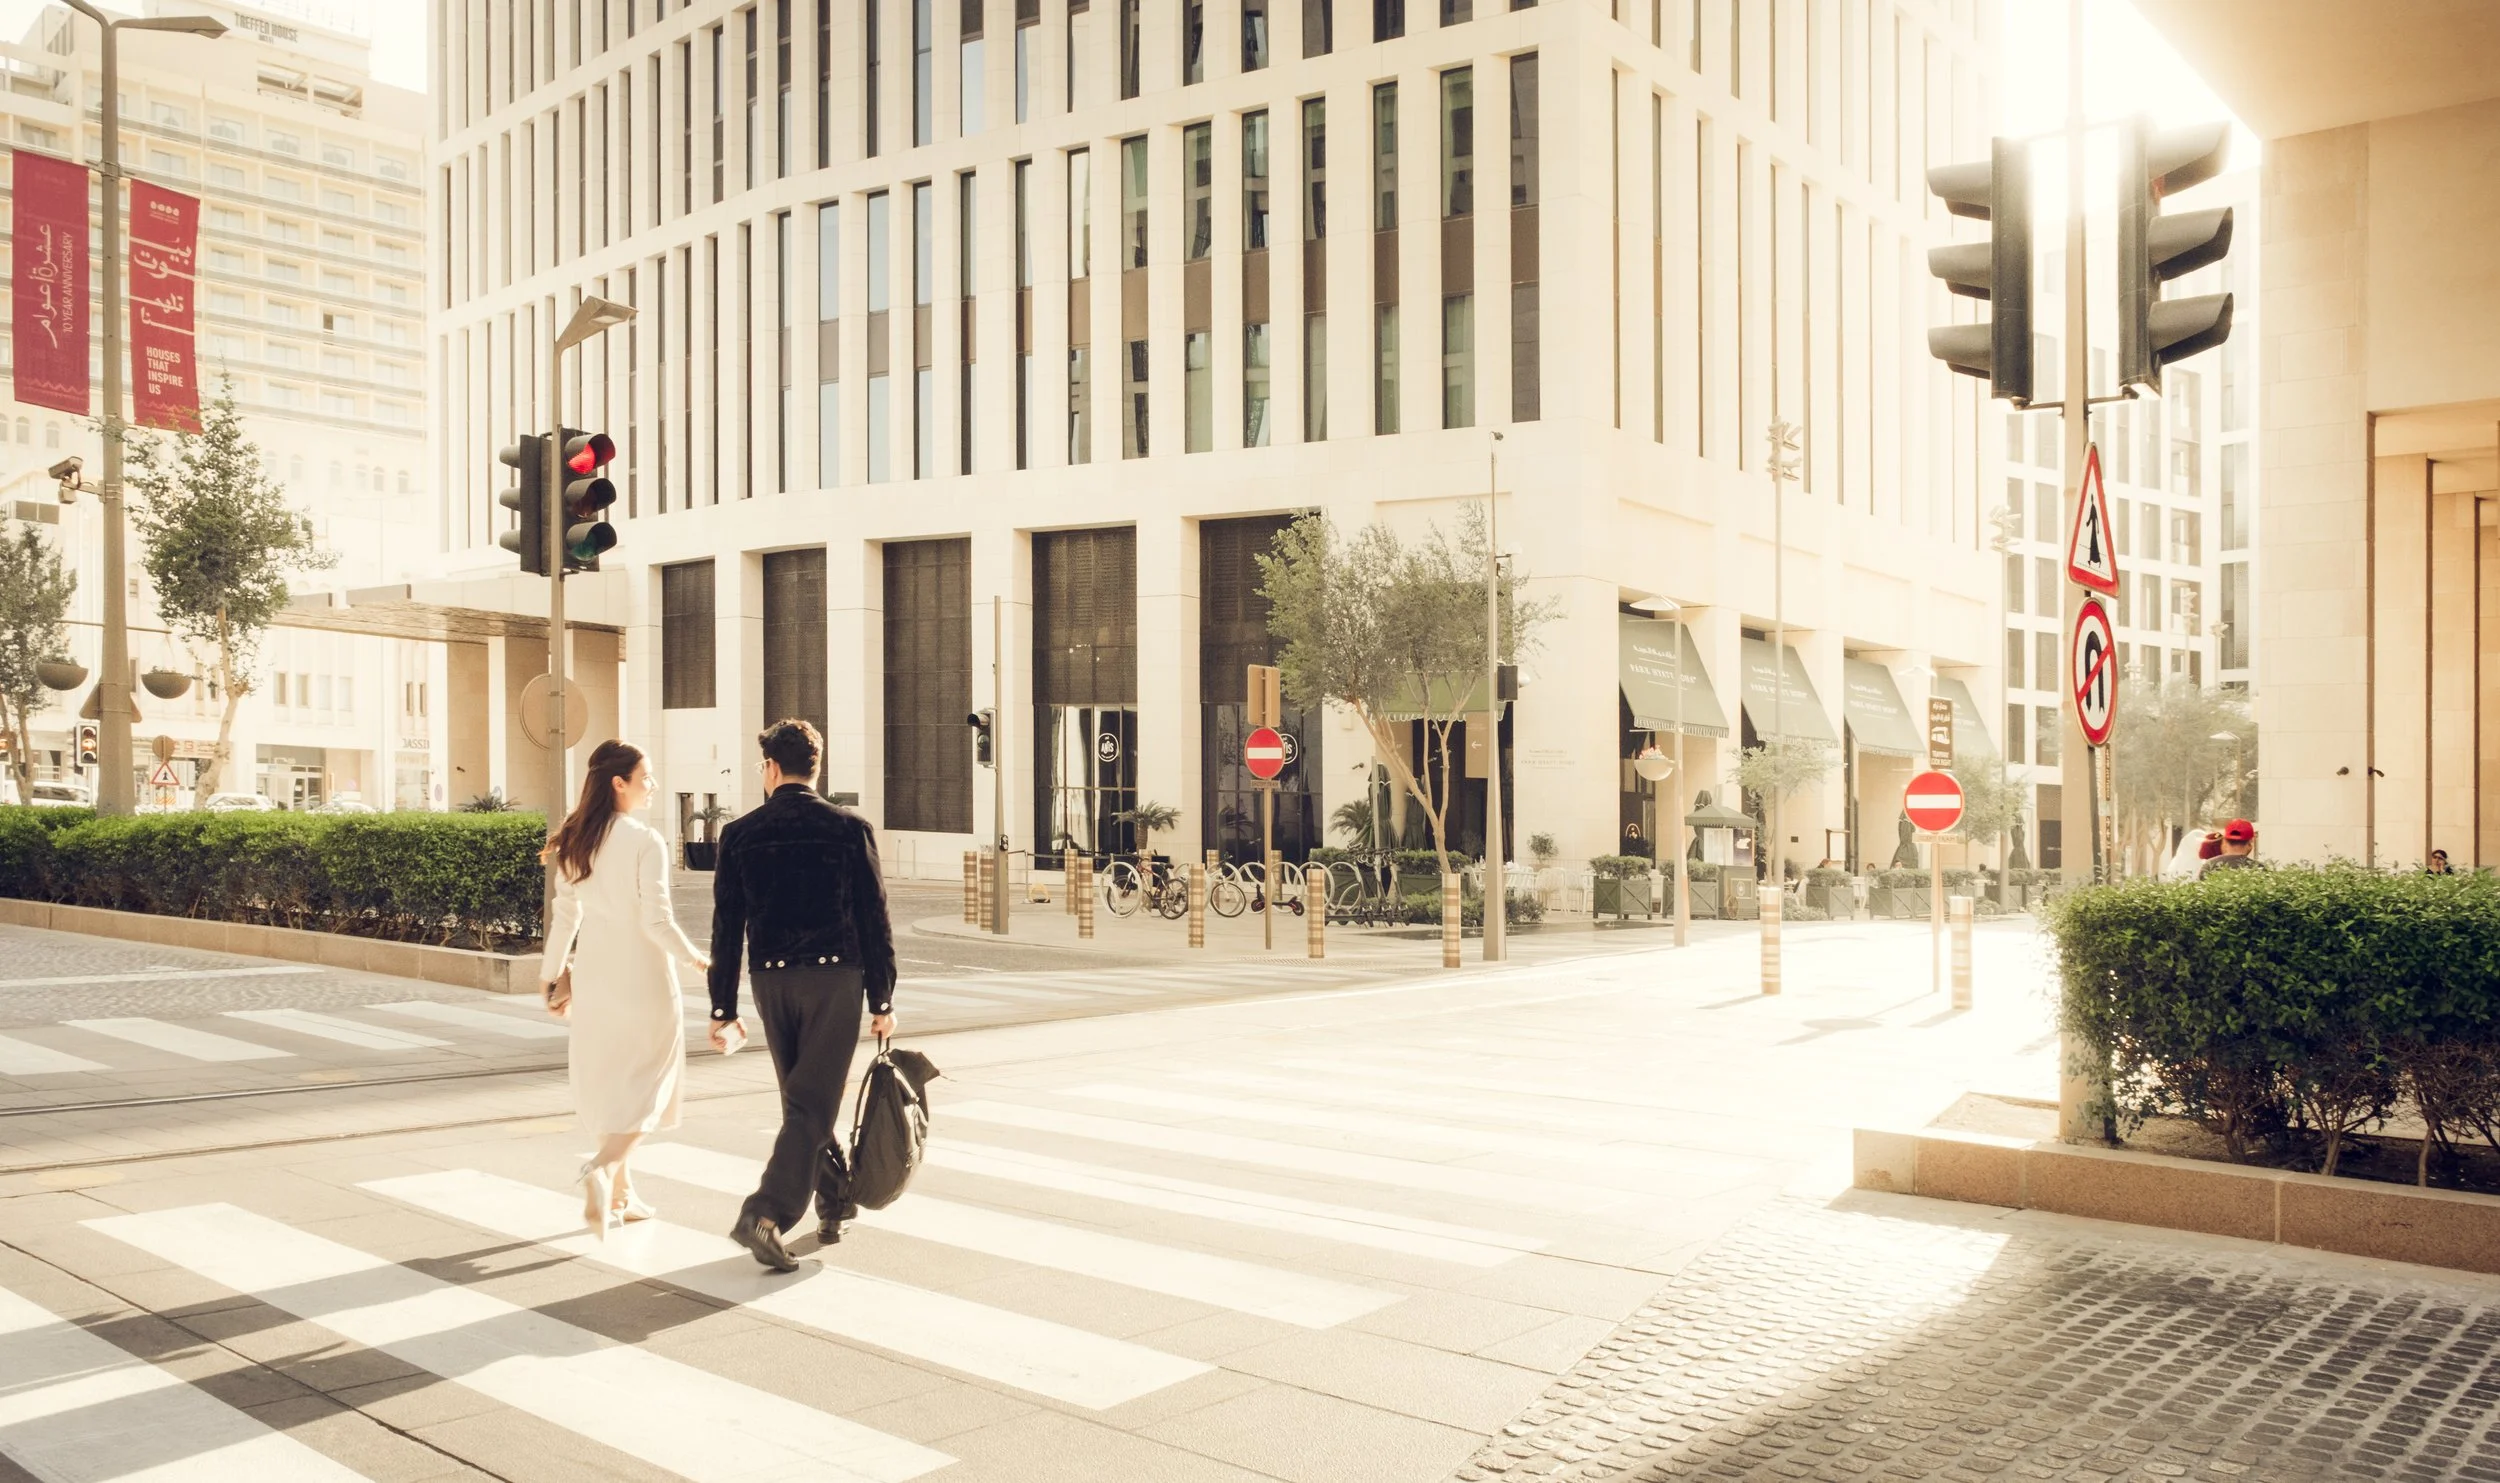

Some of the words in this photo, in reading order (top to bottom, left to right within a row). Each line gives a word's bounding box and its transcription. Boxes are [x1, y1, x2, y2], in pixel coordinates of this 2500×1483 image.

[62, 231, 73, 296] ANNIVERSARY
[62, 298, 73, 324] YEAR
[62, 324, 73, 333] 10
[146, 346, 181, 364] HOUSES
[147, 357, 169, 372] THAT
[147, 369, 184, 387] INSPIRE
[148, 383, 161, 395] US
